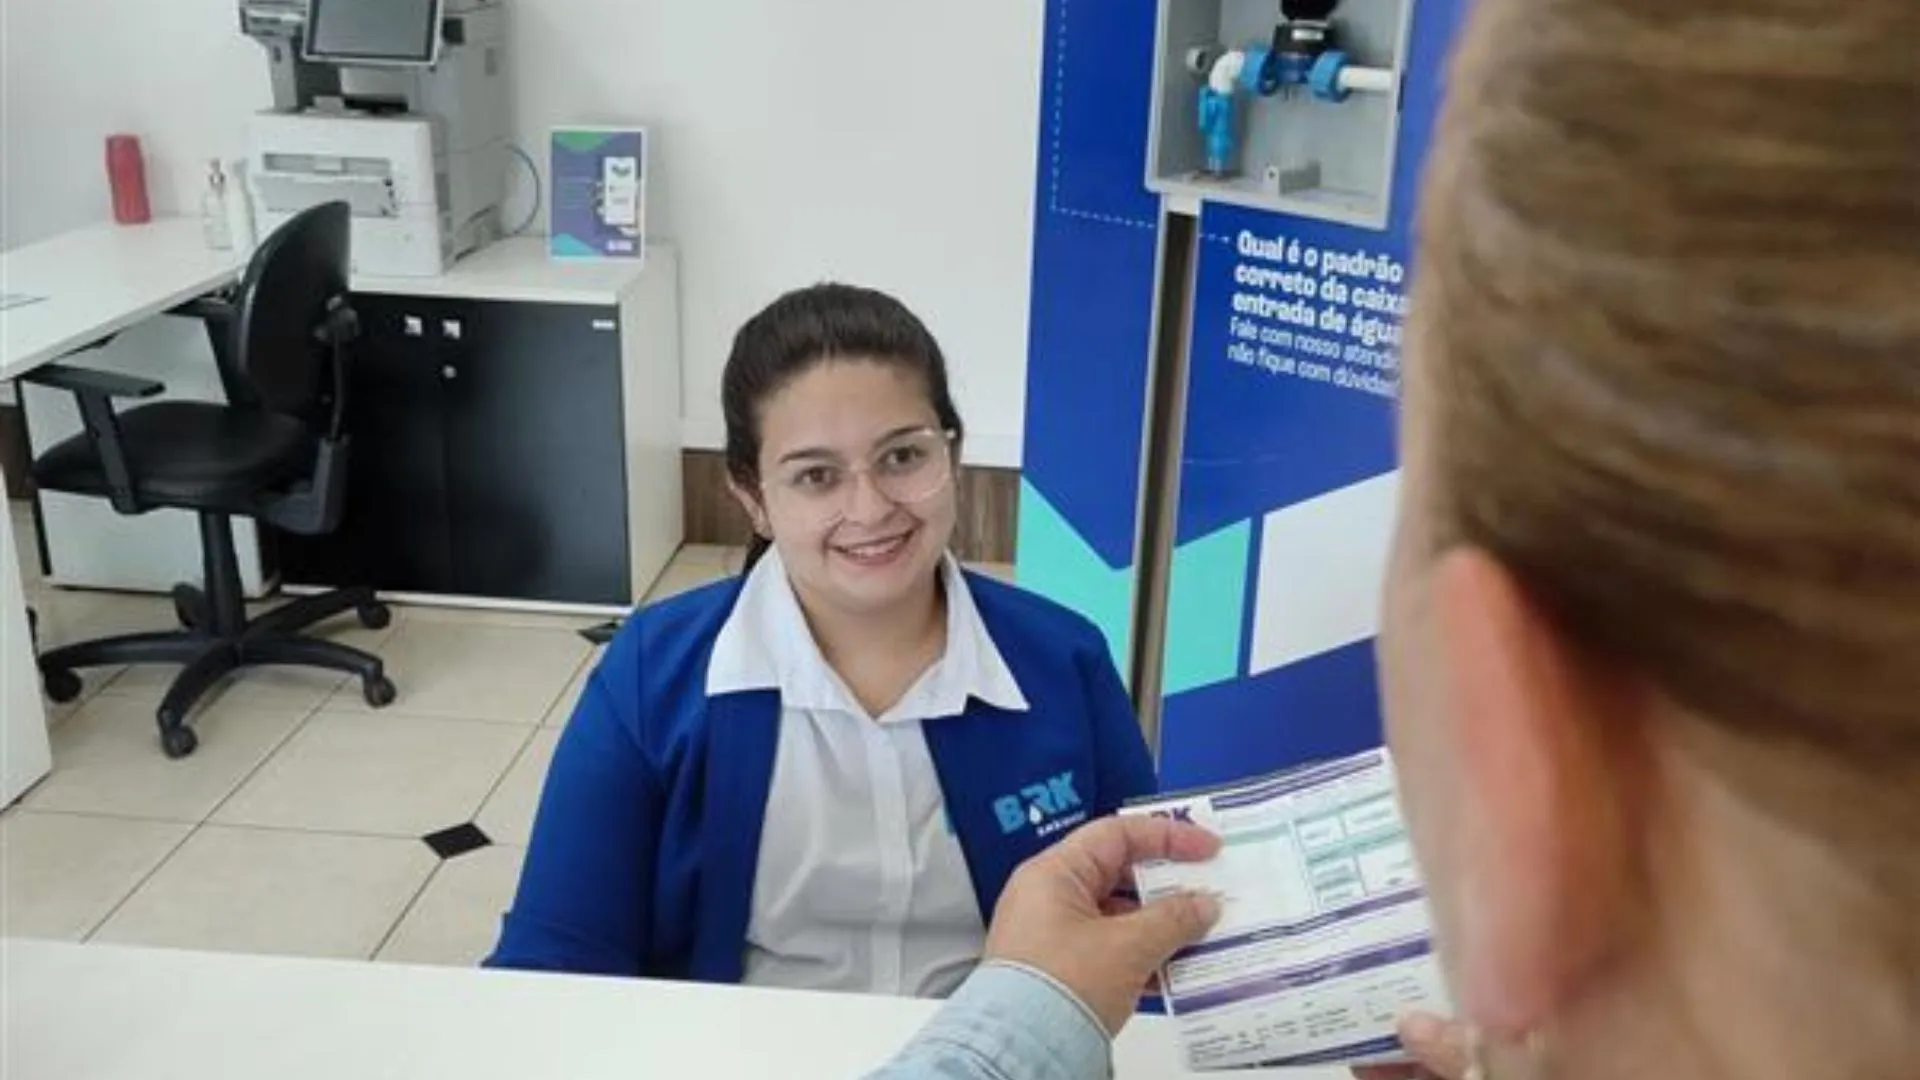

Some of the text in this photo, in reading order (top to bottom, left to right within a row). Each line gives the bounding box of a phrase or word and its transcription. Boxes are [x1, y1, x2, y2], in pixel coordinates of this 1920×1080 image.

[1237, 230, 1404, 283] Qual é o padrão
[1235, 264, 1317, 297] correto
[1319, 275, 1348, 305] da
[1232, 292, 1315, 326] entrada
[1319, 306, 1347, 334] de
[1230, 316, 1258, 341] Fale
[1260, 326, 1293, 348] com
[1295, 335, 1341, 359] nosso
[1227, 342, 1255, 366] não
[1257, 346, 1296, 375] fique
[1298, 361, 1331, 383] com
[994, 771, 1081, 833] BRK
